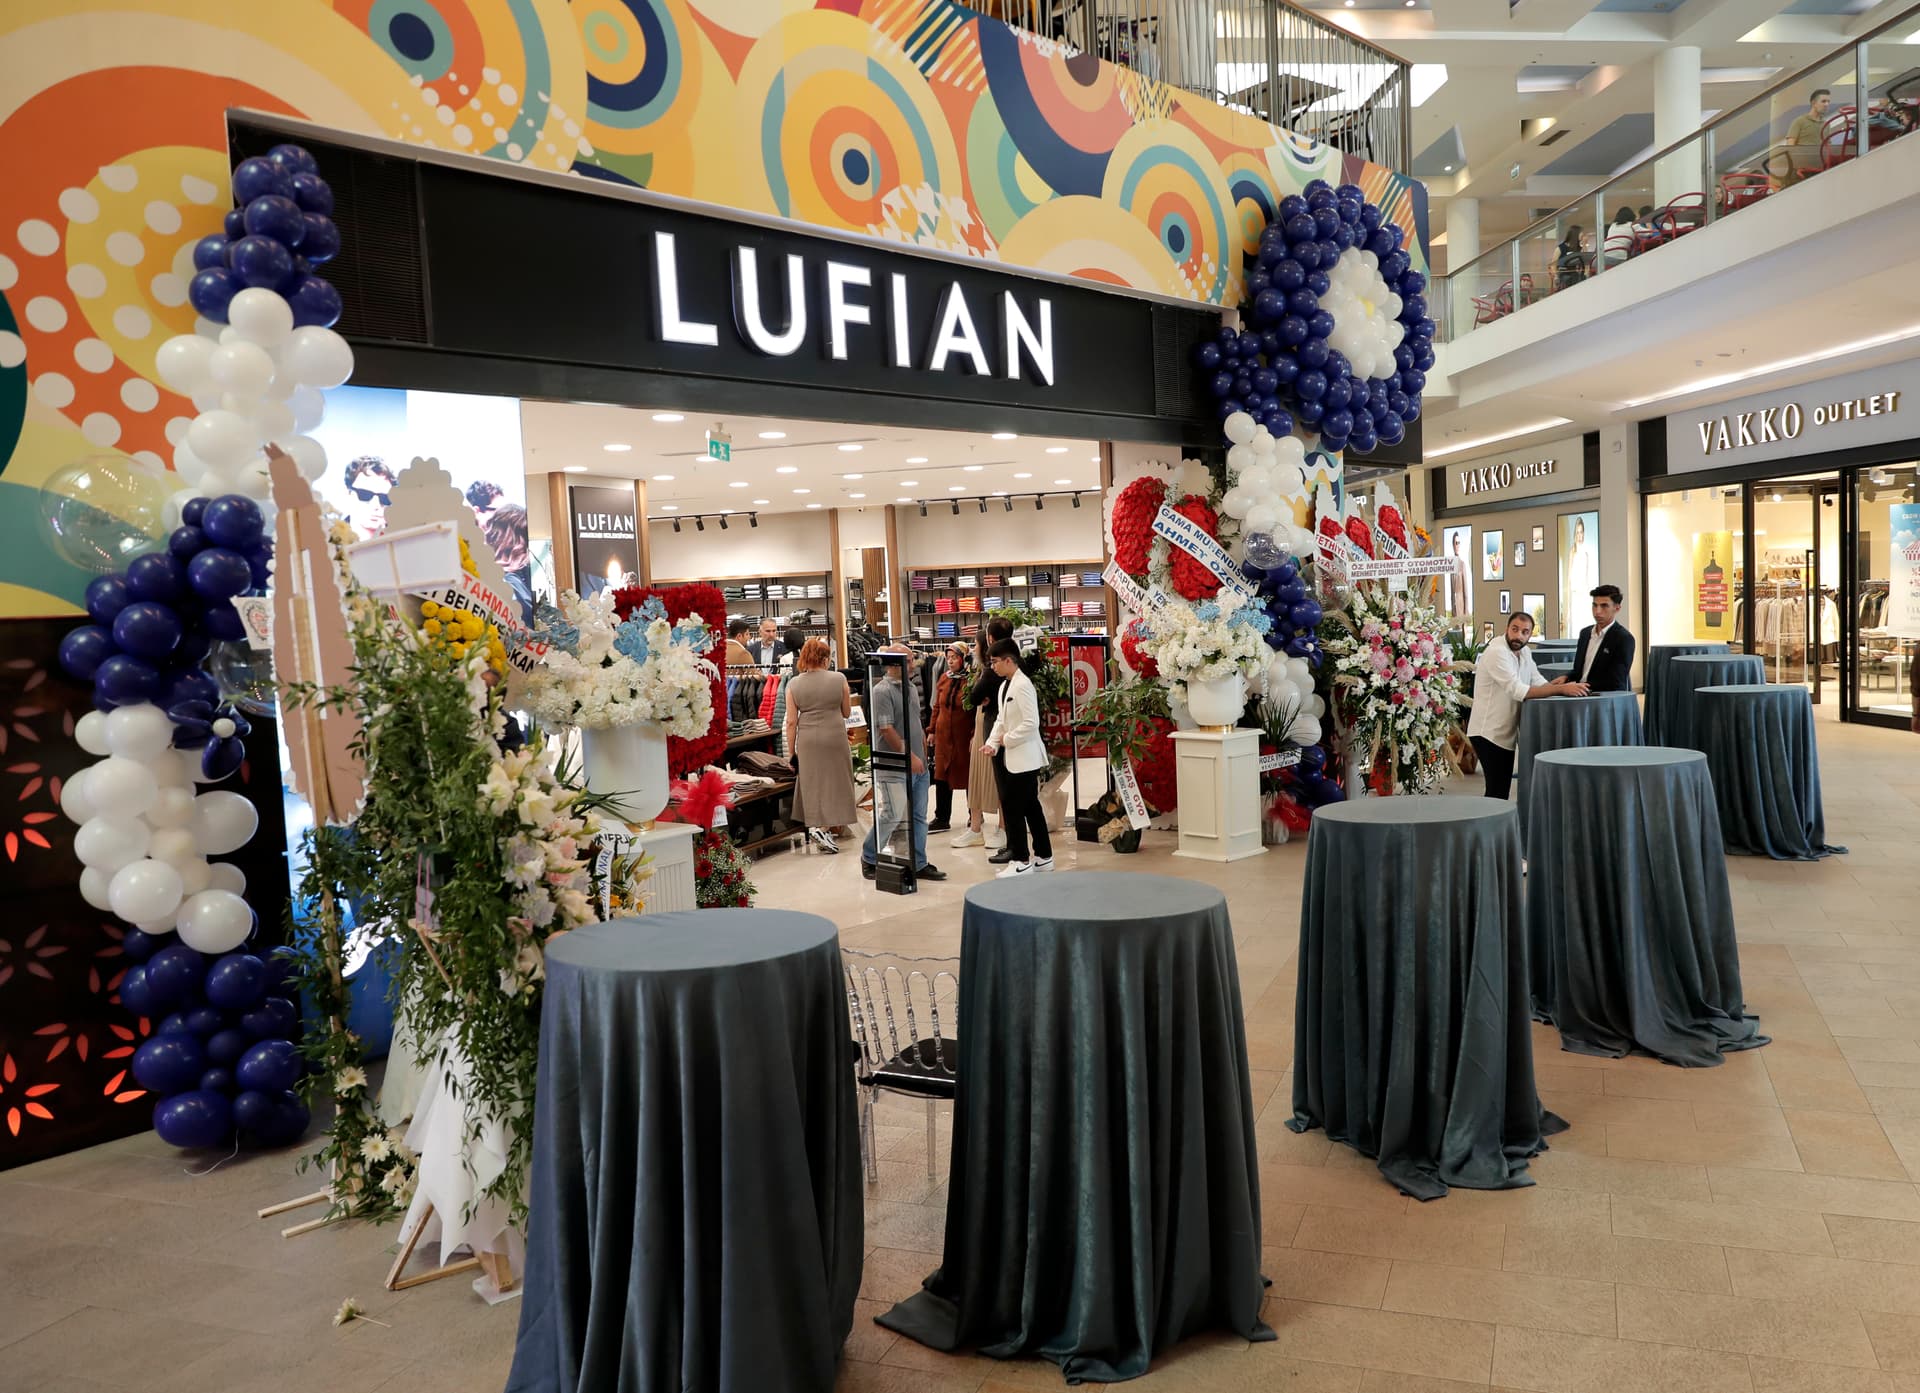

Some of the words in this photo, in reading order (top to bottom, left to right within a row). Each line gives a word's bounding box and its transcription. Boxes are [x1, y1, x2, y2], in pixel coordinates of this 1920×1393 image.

[655, 231, 1054, 386] LUFIAN
[1697, 403, 1802, 455] VAKKO
[1813, 392, 1899, 426] OUTLET
[1460, 462, 1512, 495] VAKKO
[1516, 460, 1555, 480] OUTLET
[577, 512, 634, 531] LUFIAN
[1161, 508, 1191, 533] GAMA
[1154, 522, 1208, 559] AHMET
[1366, 561, 1405, 569] MEHMET
[1407, 558, 1454, 567] OTOMOTİV
[1378, 568, 1404, 576] DURSUN
[1429, 565, 1455, 573] DURSUN
[1133, 794, 1145, 816] GYO
